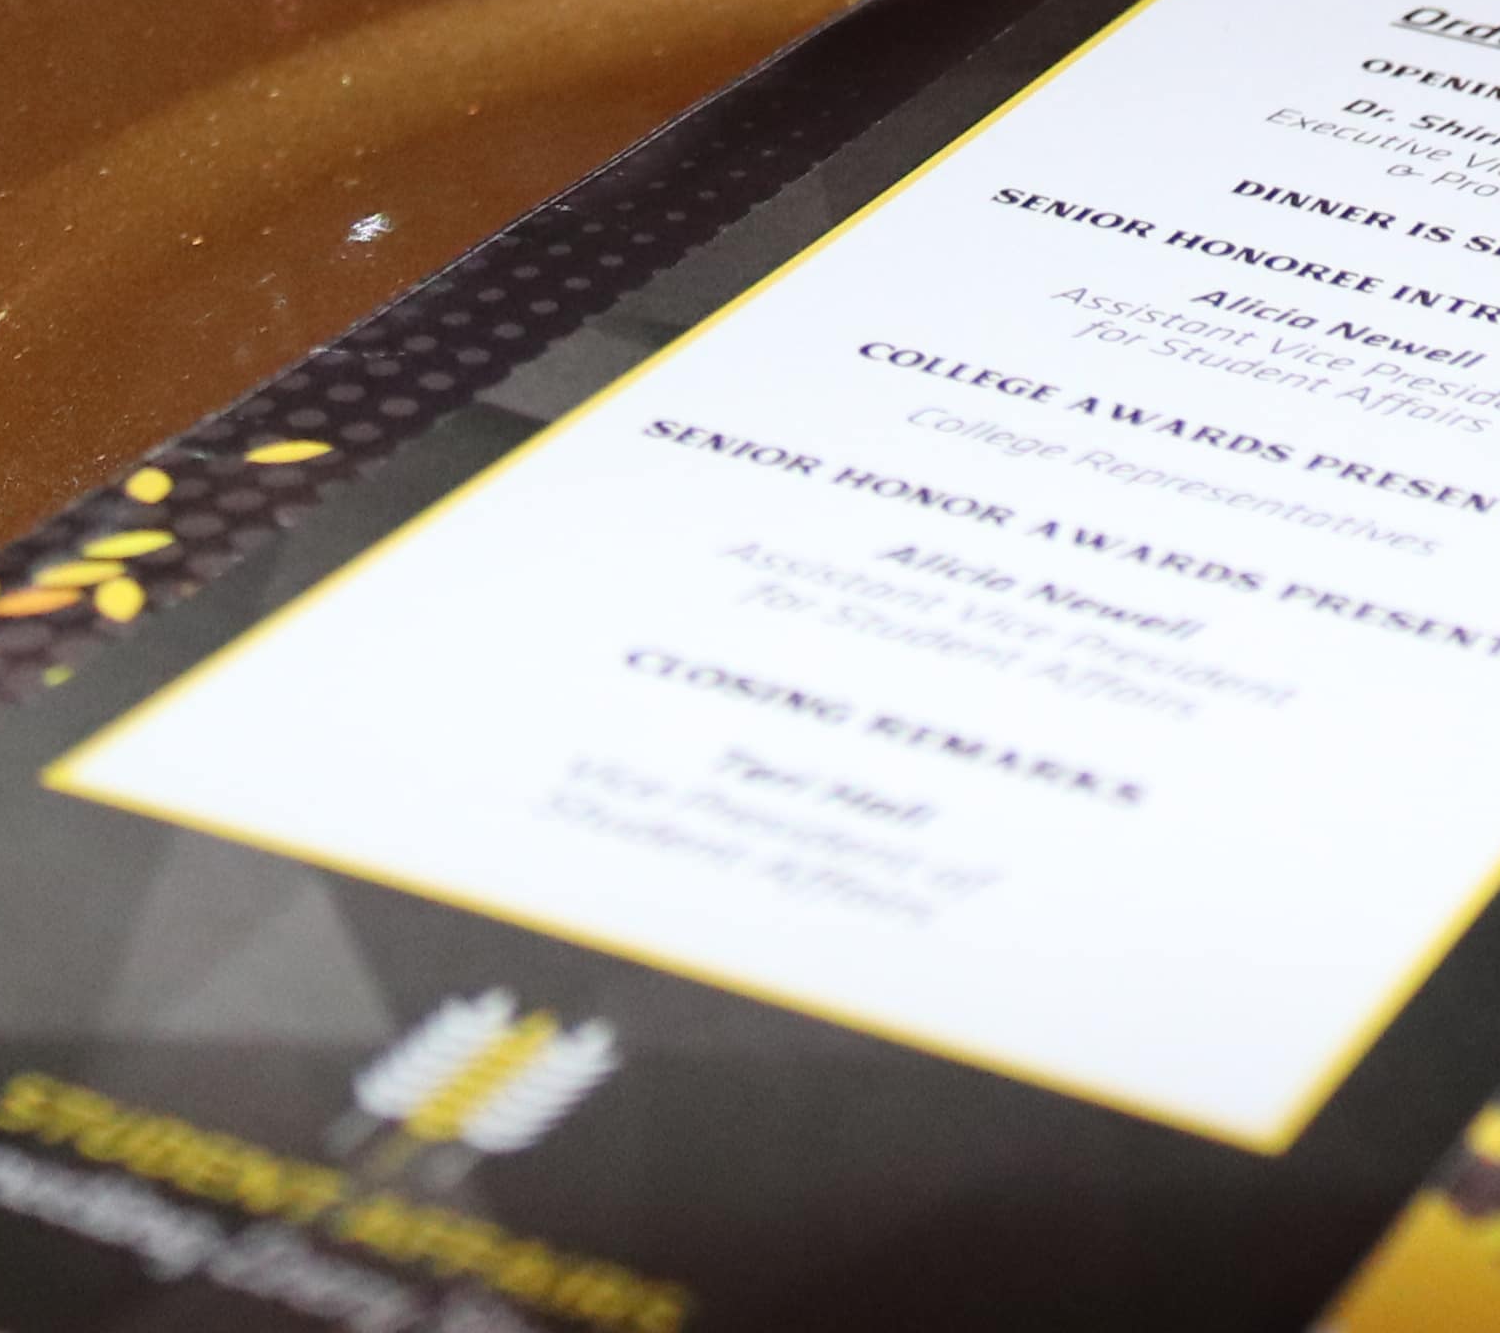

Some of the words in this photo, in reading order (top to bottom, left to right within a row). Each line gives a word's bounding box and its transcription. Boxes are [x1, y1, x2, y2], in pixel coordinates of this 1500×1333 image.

[1266, 107, 1452, 161] Executive
[1342, 99, 1395, 122] Dr.
[991, 188, 1157, 238] SENIOR
[1164, 230, 1384, 294] HONOREE
[1231, 179, 1397, 231] DINNER
[1406, 221, 1455, 243] IS
[1050, 287, 1262, 347] Assistant
[1268, 337, 1357, 371] Vice
[1072, 320, 1147, 346] for
[1149, 338, 1333, 393] Student
[1335, 386, 1492, 433] Affairs
[1190, 290, 1319, 329] Alicia
[1325, 321, 1487, 369] Newell
[857, 342, 1061, 403] COLLEGE
[1066, 395, 1296, 463] AWARDS
[642, 419, 824, 477] SENIOR
[832, 467, 1017, 527] HONOR
[1027, 520, 1265, 591] AWARDS
[907, 407, 1069, 460] College
[1073, 450, 1444, 556] Representatives
[626, 649, 850, 721] CLOSING
[869, 714, 1145, 804] REMARKS
